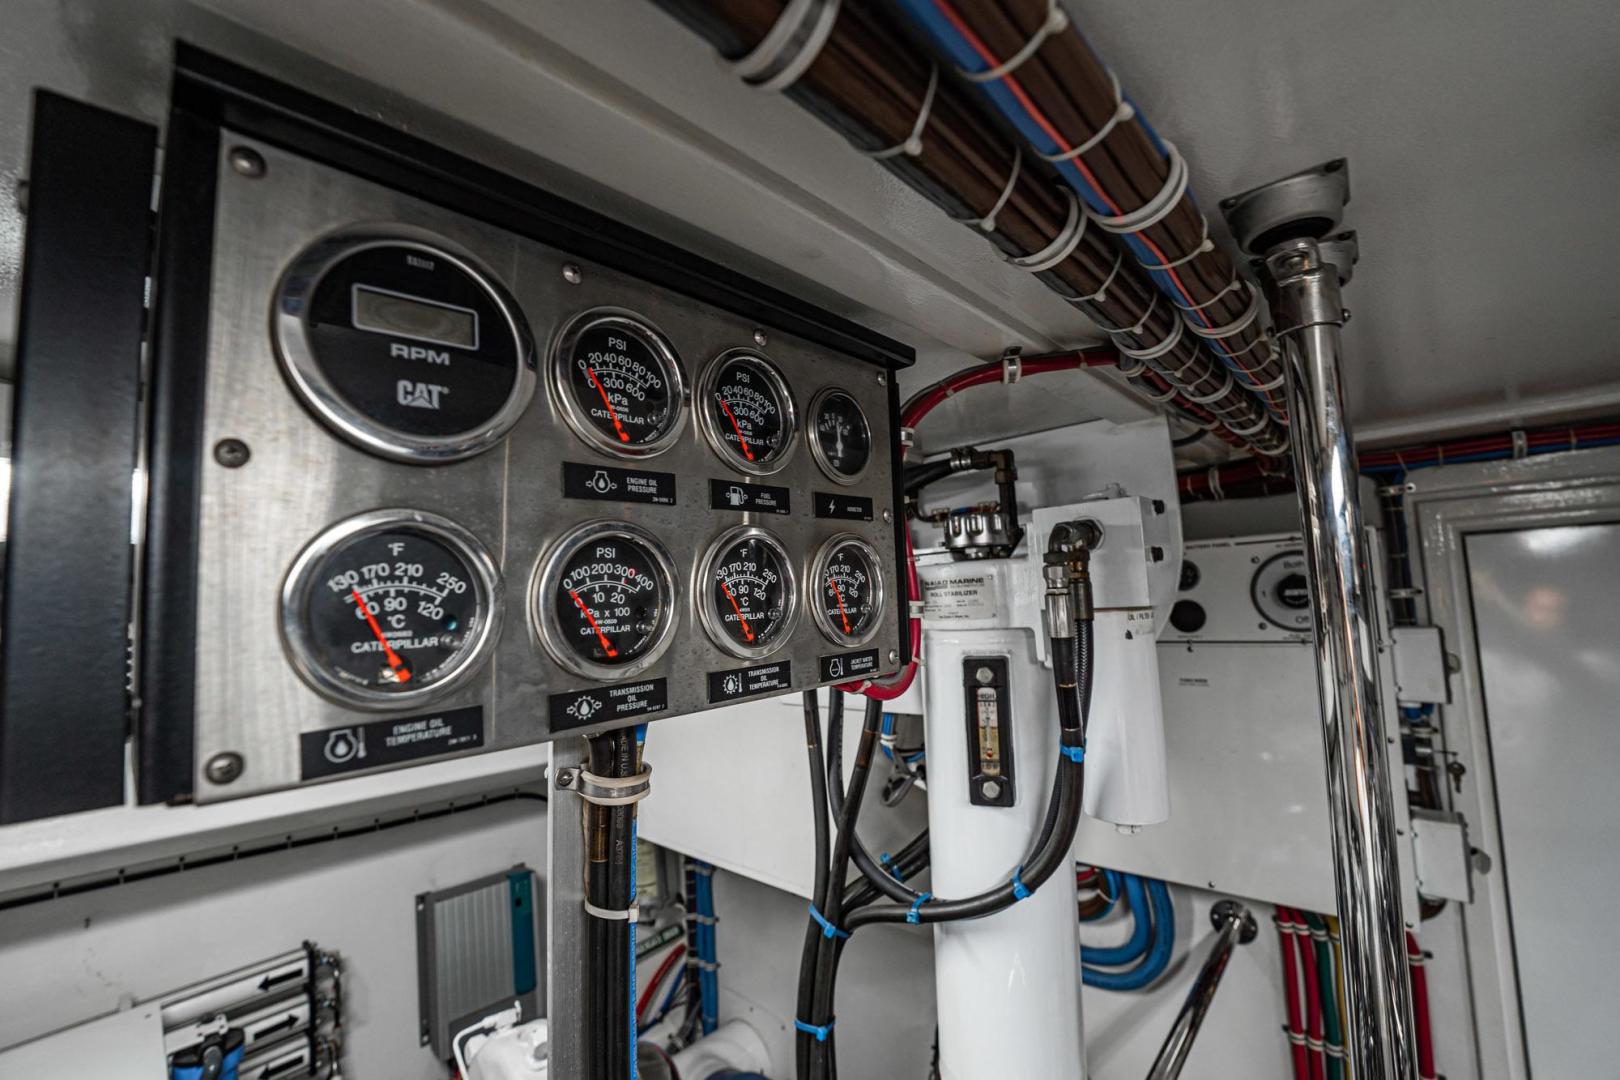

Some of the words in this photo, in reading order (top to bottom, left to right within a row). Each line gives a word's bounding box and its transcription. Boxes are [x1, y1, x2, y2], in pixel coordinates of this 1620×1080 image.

[608, 337, 627, 351] PSI
[390, 343, 450, 366] RPM
[578, 359, 587, 370] 0
[588, 352, 602, 363] 20
[603, 353, 617, 363] 40
[618, 355, 632, 368] 60
[632, 361, 646, 376] 80
[645, 371, 661, 389] 100
[736, 372, 750, 383] PSI
[603, 377, 624, 390] 300
[626, 383, 645, 401] 600
[607, 392, 629, 406] kPa
[722, 386, 733, 395] 20
[733, 386, 743, 395] 40
[743, 387, 754, 398] 60
[753, 392, 764, 404] 80
[763, 400, 775, 415] 100
[733, 407, 749, 416] 300
[749, 411, 764, 425] 600
[626, 476, 648, 486] ENGINE
[648, 479, 658, 487] OIL
[627, 485, 657, 494] PRESSURE
[596, 547, 616, 559] PSI
[728, 562, 742, 573] 170
[743, 562, 756, 571] 210
[762, 568, 777, 583] 250
[829, 565, 839, 574] 170
[840, 564, 851, 573] 210
[327, 570, 359, 593] 130
[361, 563, 390, 579] 170
[394, 562, 423, 578] 210
[436, 572, 467, 594] 250
[563, 578, 573, 590] 0
[570, 566, 590, 581] 100
[591, 563, 613, 574] 200
[614, 564, 635, 579] 300
[635, 574, 654, 591] 400
[950, 577, 984, 585] MARINE
[592, 592, 605, 603] 10
[610, 593, 625, 604] 20
[738, 585, 749, 594] 90
[753, 587, 766, 601] 120
[384, 597, 407, 612] 90
[417, 600, 444, 620] 120
[614, 607, 630, 617] 100
[580, 624, 631, 636] CATRPILLAR
[748, 666, 780, 677] TRANSMISSION
[609, 684, 654, 698] TRANSMISSION
[749, 679, 779, 691] TEMPERATURE
[627, 694, 637, 702] OIL
[616, 699, 648, 713] PRESSURE
[392, 720, 427, 736] ENGINE
[429, 717, 445, 728] OIL
[385, 725, 452, 748] TEMPERATURE
